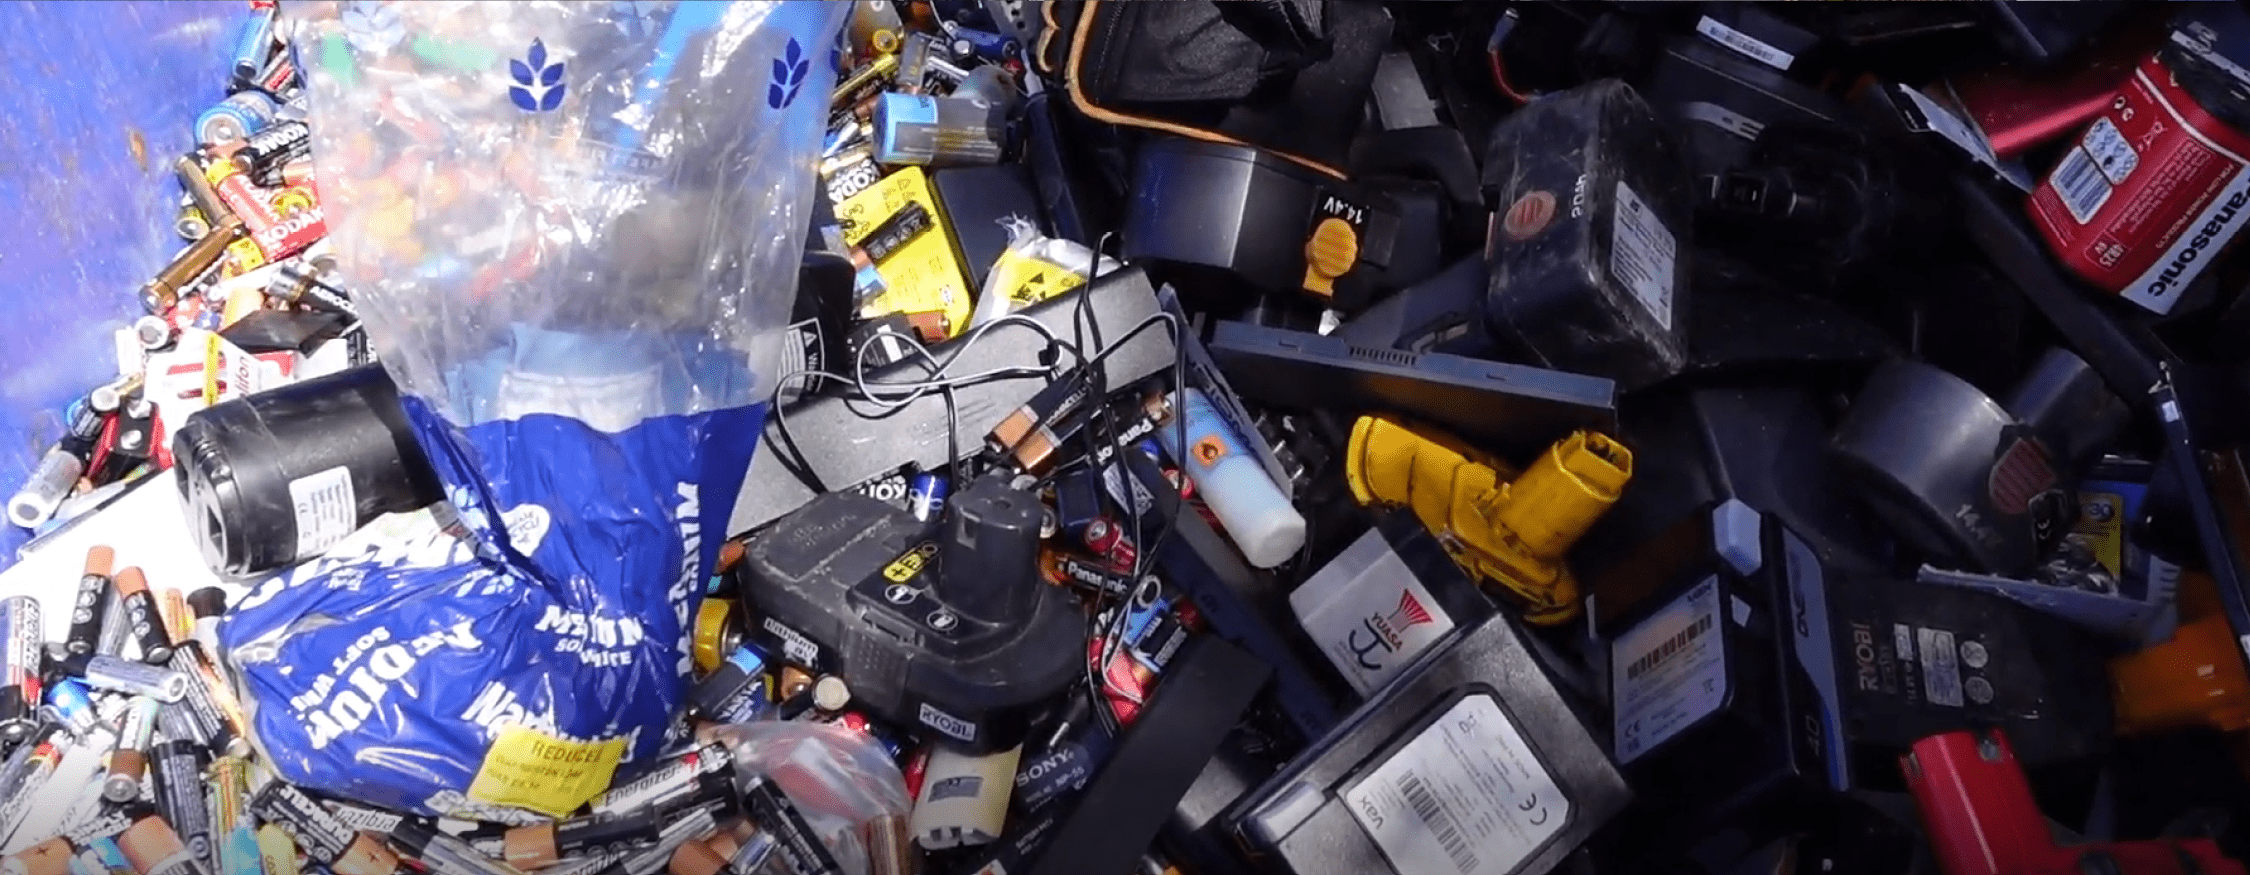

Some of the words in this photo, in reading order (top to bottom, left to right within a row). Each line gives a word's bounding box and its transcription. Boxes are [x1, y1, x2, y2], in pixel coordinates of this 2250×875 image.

[828, 165, 881, 204] KODA
[1323, 196, 1362, 224] 14.4V
[1067, 560, 1129, 594] Pananic
[1371, 611, 1404, 651] YUASA
[1852, 622, 1879, 691] RYOBI
[920, 705, 975, 740] RYOBI
[1015, 747, 1070, 788] SONY
[279, 784, 354, 846] DURACELL
[1360, 795, 1385, 830] vax
